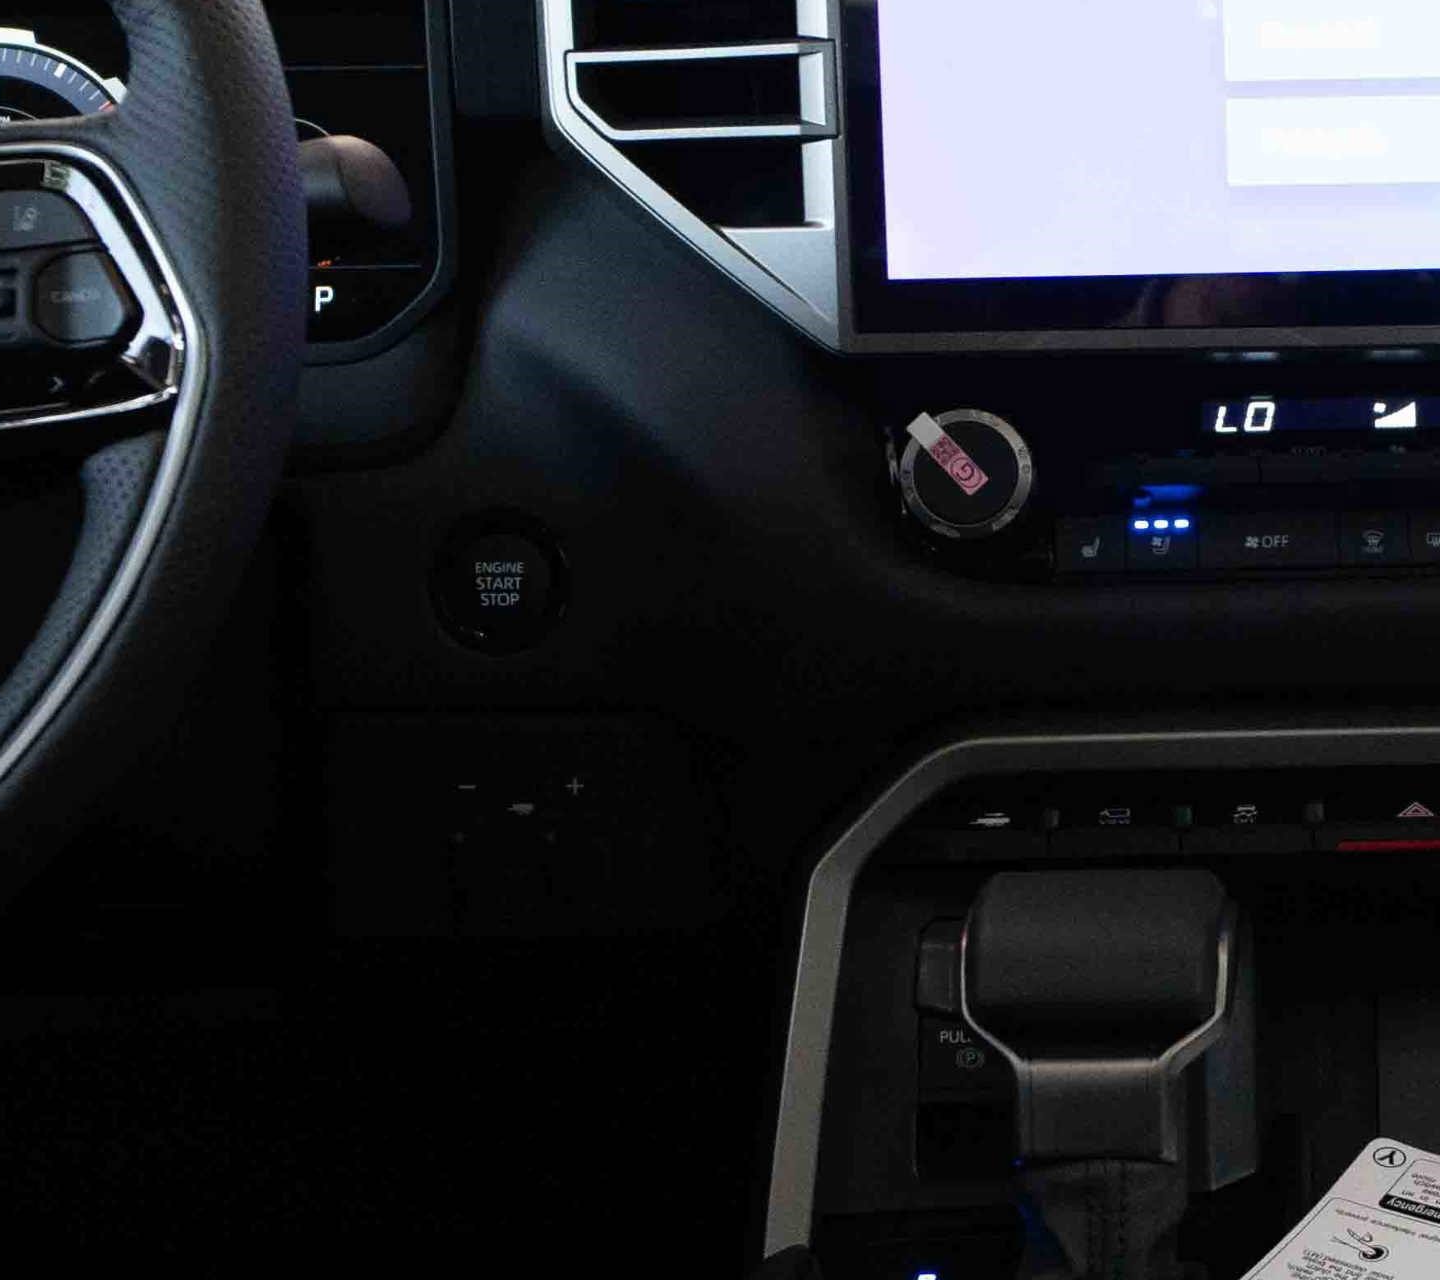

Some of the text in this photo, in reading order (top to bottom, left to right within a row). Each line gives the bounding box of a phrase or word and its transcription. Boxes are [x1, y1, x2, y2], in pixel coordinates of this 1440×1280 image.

[314, 285, 335, 314] P
[1213, 400, 1277, 433] LO
[1262, 533, 1290, 550] OFF
[474, 561, 526, 575] ENGINE
[474, 576, 523, 591] START
[479, 592, 521, 607] STOP
[1379, 1149, 1398, 1165] Y
